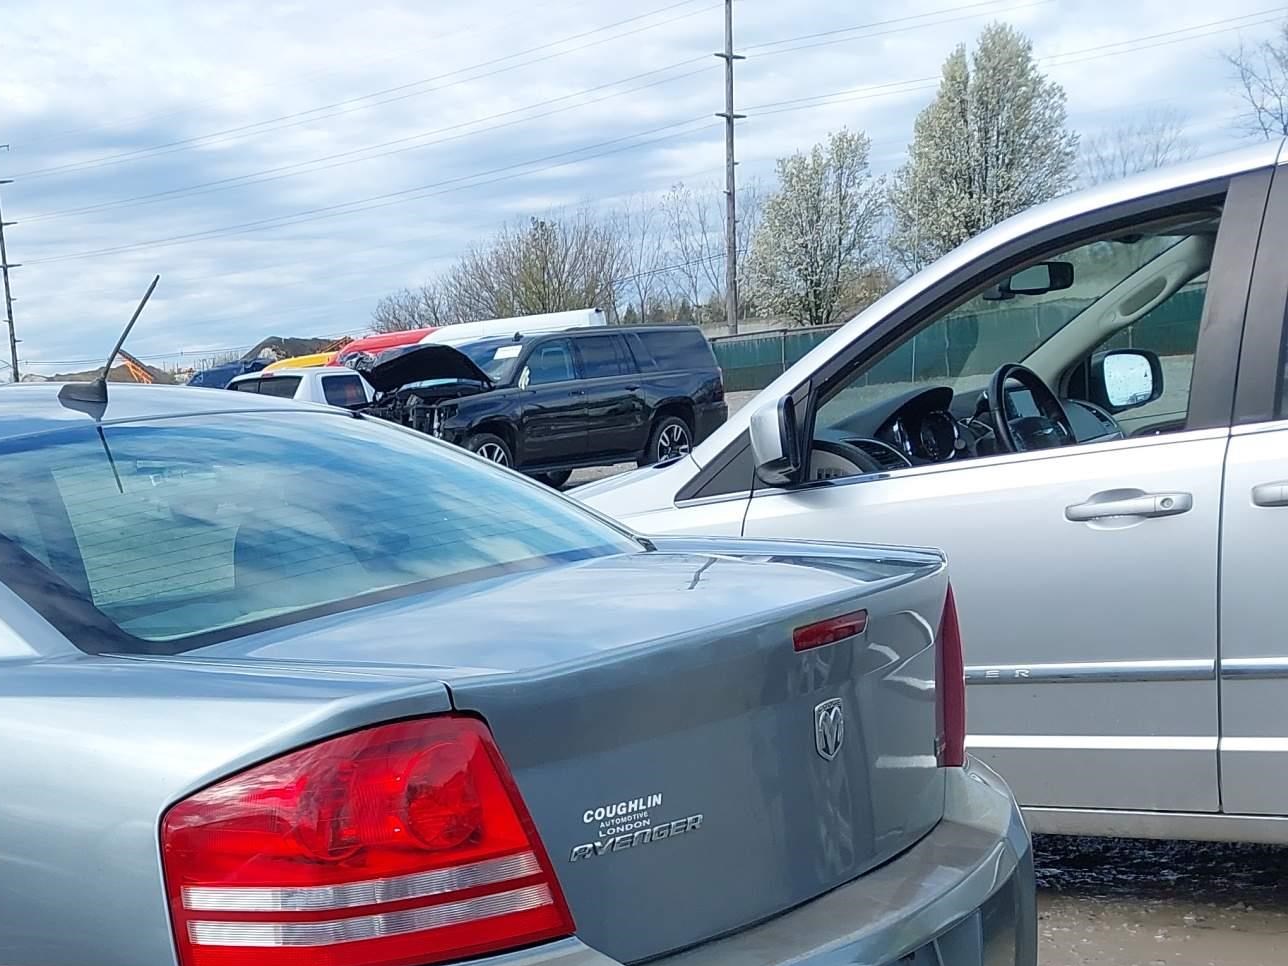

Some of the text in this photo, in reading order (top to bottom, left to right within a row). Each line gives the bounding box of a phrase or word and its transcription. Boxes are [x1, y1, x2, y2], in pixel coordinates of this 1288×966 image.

[583, 793, 663, 824] COUGHLIN
[599, 811, 649, 828] AUTOMOTIVE
[569, 814, 704, 862] AVENGER
[598, 819, 651, 838] LONDON
